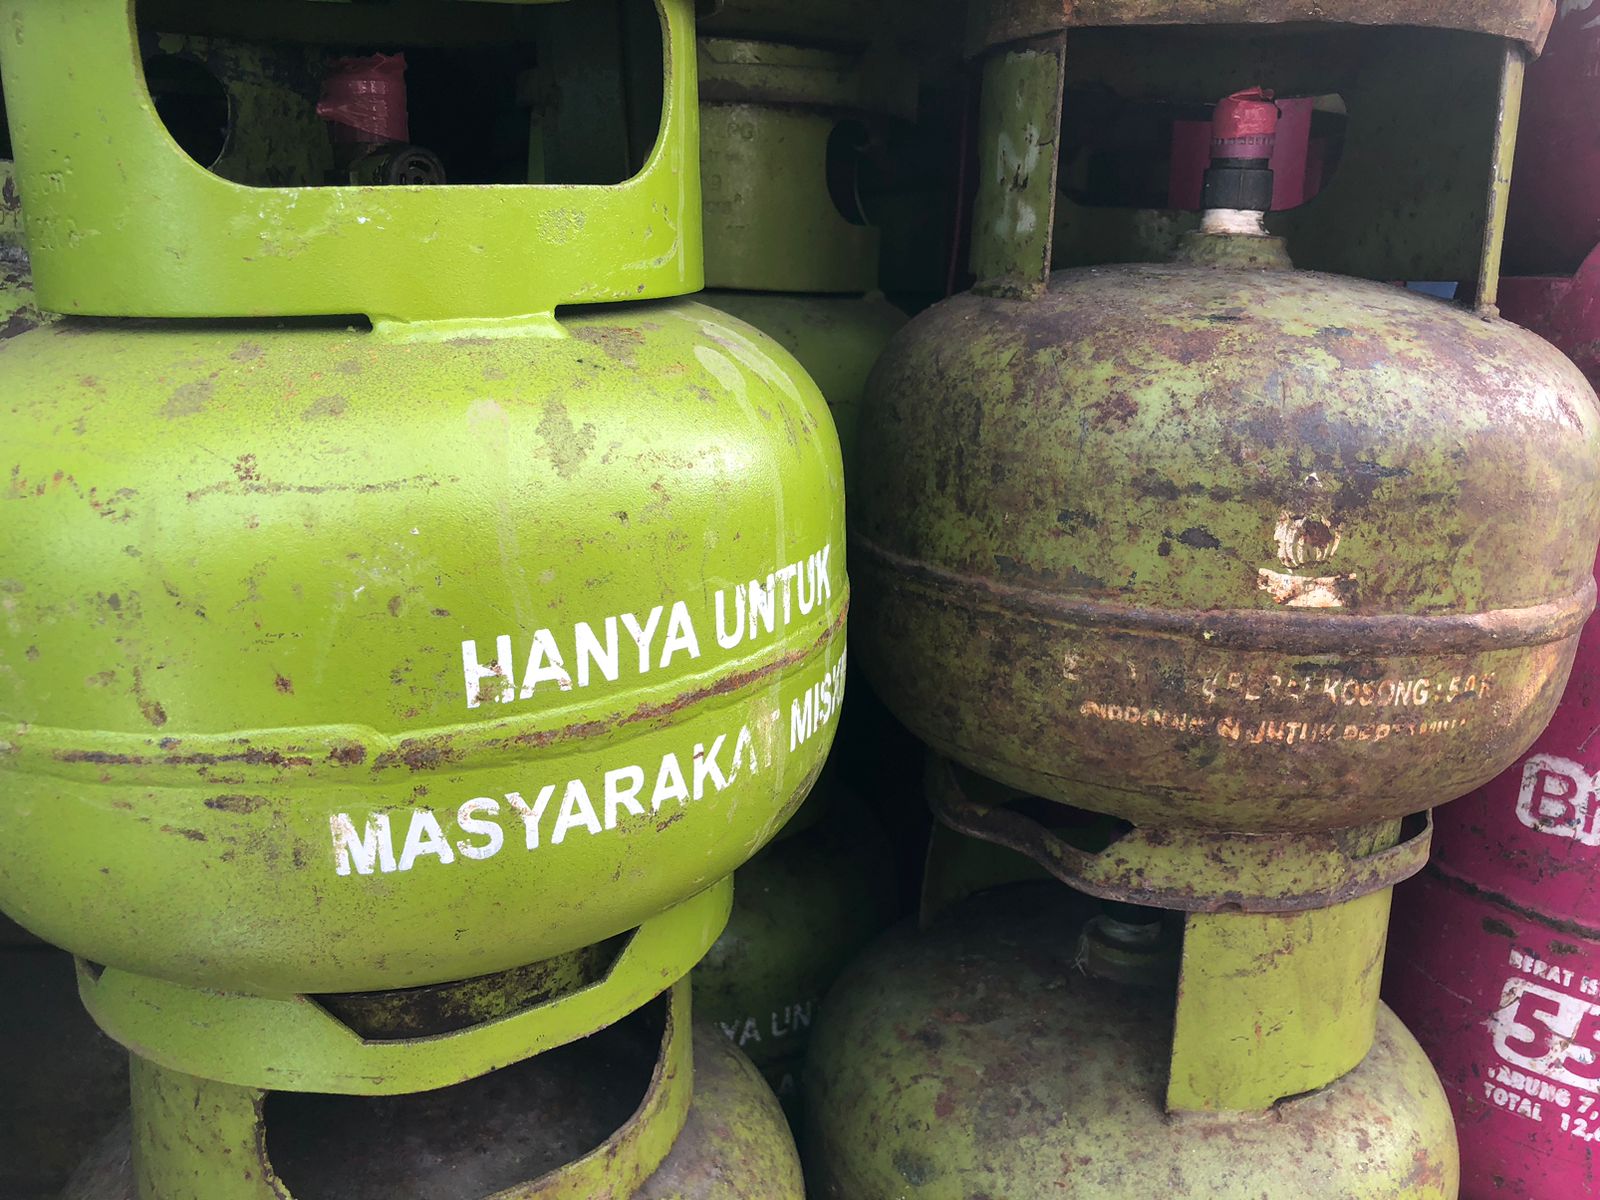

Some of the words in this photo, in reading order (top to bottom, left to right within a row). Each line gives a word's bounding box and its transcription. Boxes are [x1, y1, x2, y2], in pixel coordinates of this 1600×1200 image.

[461, 601, 702, 708] HANYA
[715, 544, 832, 650] UNTUK
[1323, 677, 1430, 707] KOSONG
[1508, 949, 1575, 988] BERAT
[1579, 974, 1600, 996] IS
[714, 1016, 762, 1047] YA
[770, 1001, 812, 1037] UN
[1483, 1081, 1542, 1122] TOTAL
